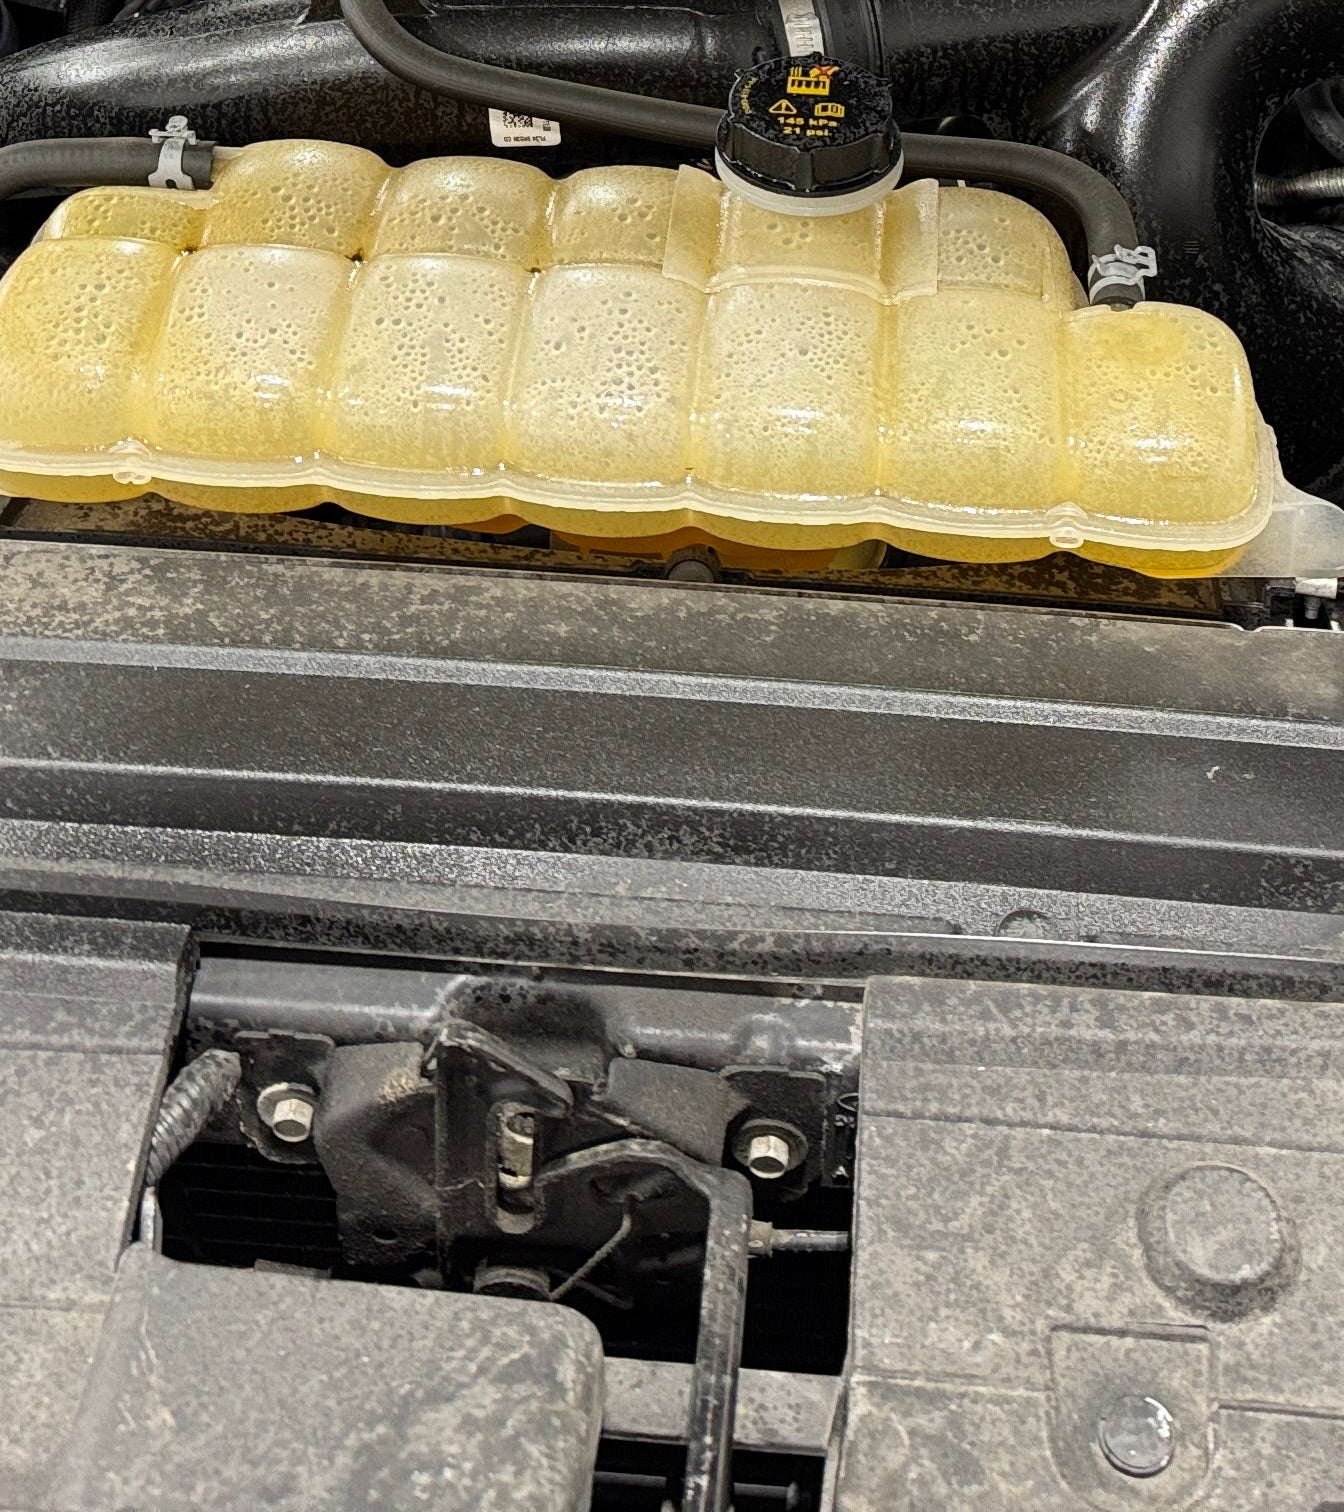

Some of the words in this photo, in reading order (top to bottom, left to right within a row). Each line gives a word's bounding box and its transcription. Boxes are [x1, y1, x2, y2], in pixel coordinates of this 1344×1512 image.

[776, 116, 805, 125] 145
[809, 118, 838, 127] kPa
[783, 126, 801, 135] 21
[806, 128, 829, 137] psi
